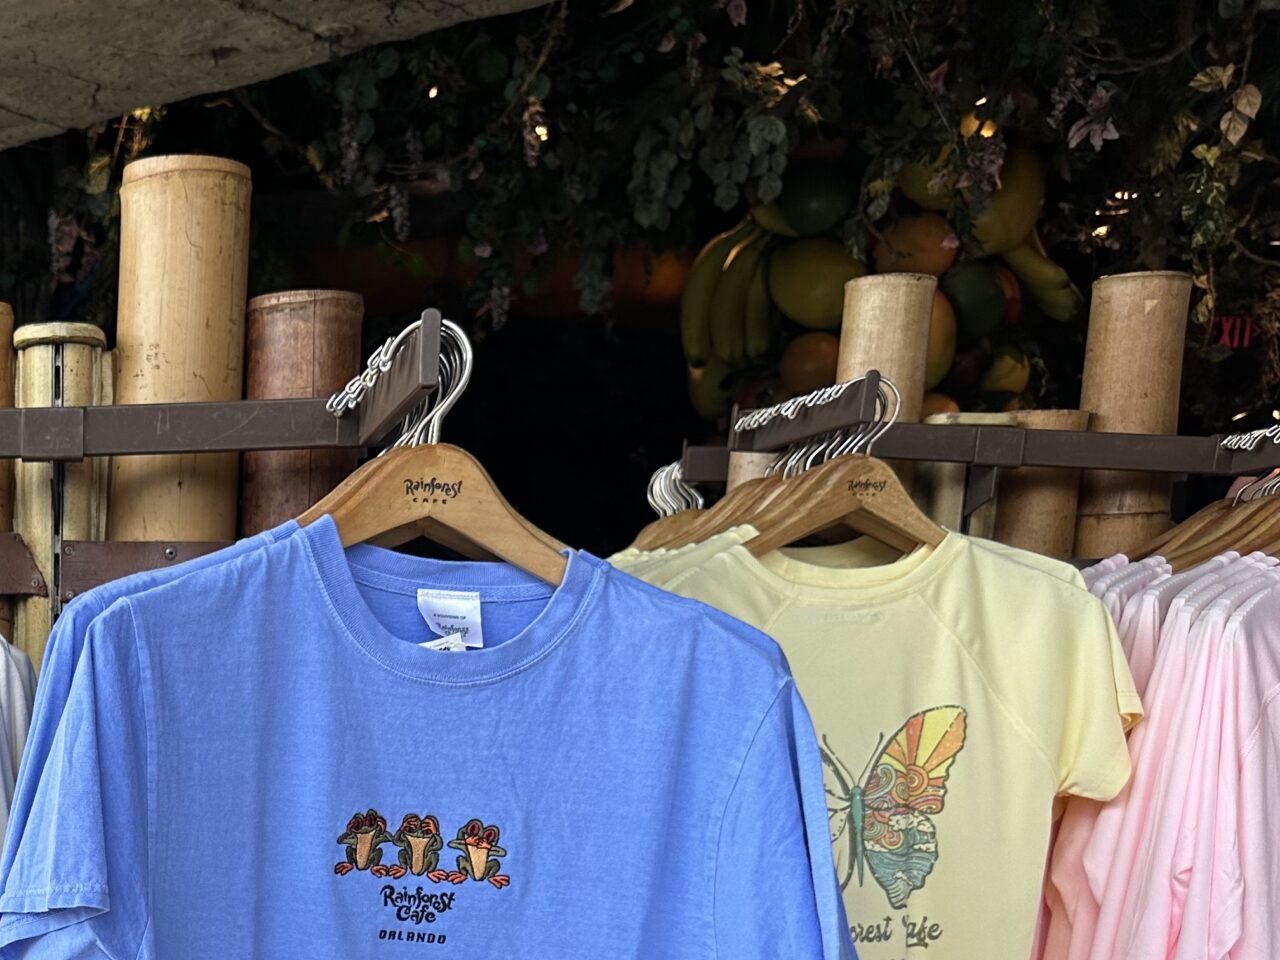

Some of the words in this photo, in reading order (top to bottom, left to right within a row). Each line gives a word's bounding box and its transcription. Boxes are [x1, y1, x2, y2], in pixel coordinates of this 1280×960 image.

[403, 477, 462, 499] Rainforest
[412, 497, 447, 505] CAFE
[380, 884, 455, 913] Rainforest
[396, 904, 436, 925] Cafe
[378, 929, 447, 945] ORLANDO
